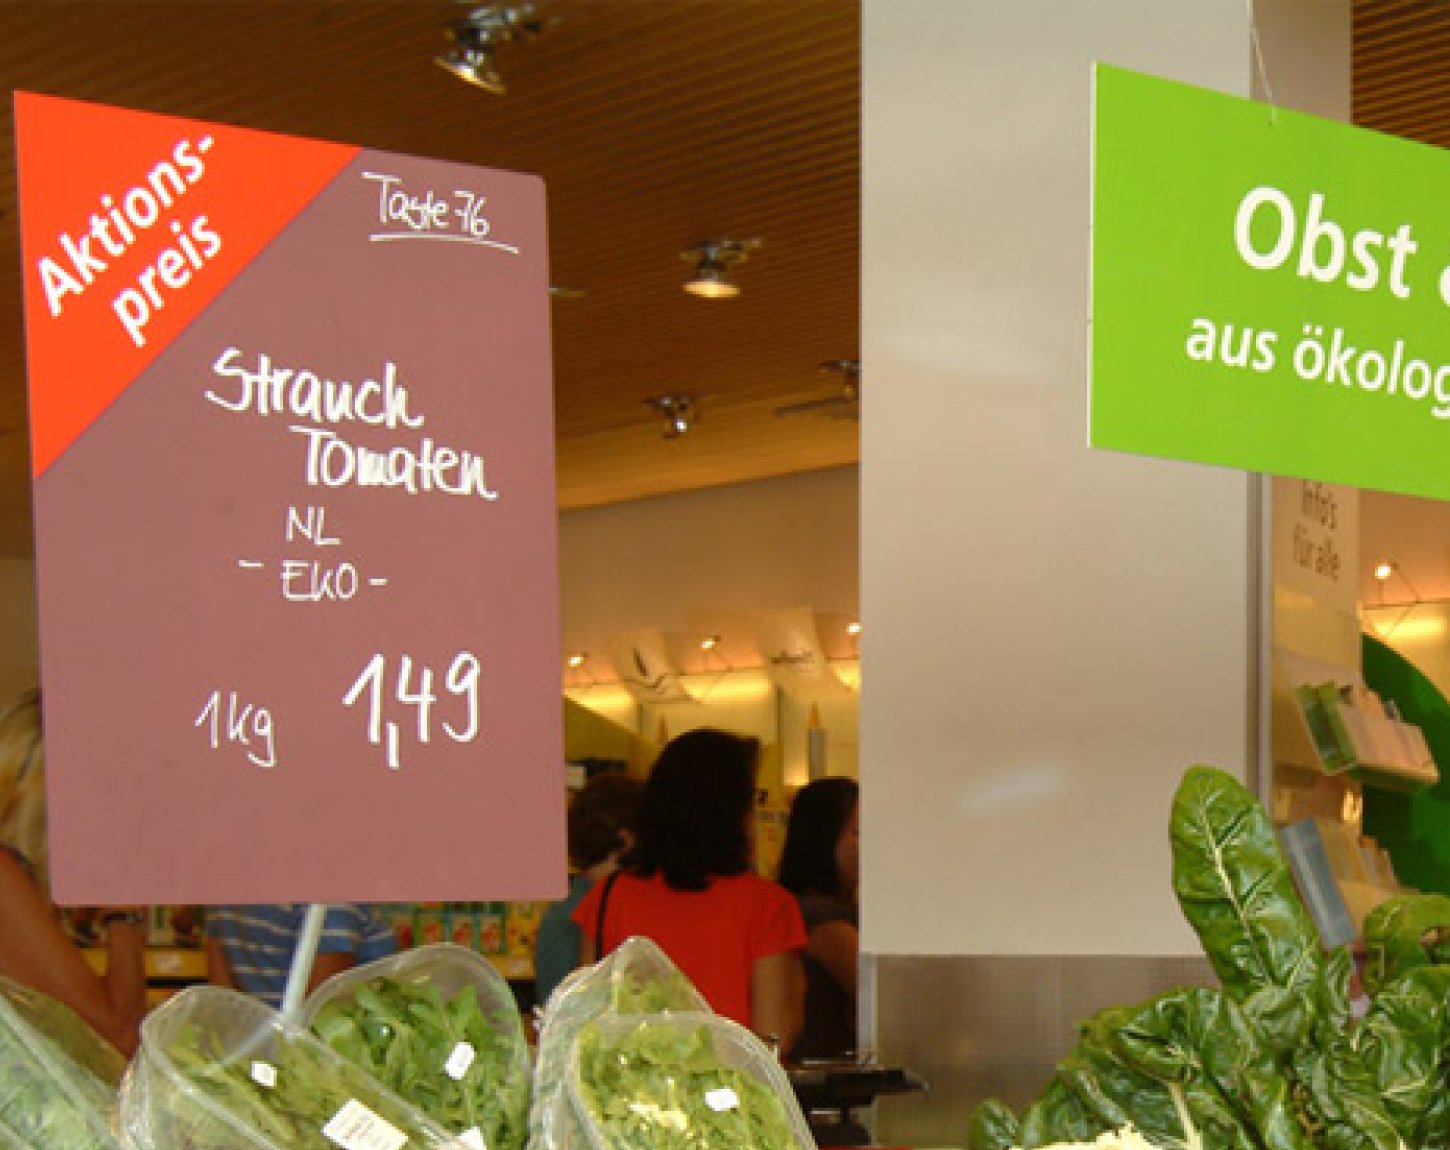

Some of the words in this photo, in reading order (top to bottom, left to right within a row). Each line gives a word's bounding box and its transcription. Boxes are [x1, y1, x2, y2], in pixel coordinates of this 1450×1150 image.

[38, 134, 215, 318] Aktions-
[454, 190, 491, 237] 76
[1233, 185, 1417, 300] Obst
[112, 215, 222, 347] preis
[1185, 317, 1279, 372] aus
[204, 346, 425, 429] Strauch
[288, 424, 498, 501] Tomaten
[286, 506, 342, 545] NL
[342, 650, 481, 771] 1,49
